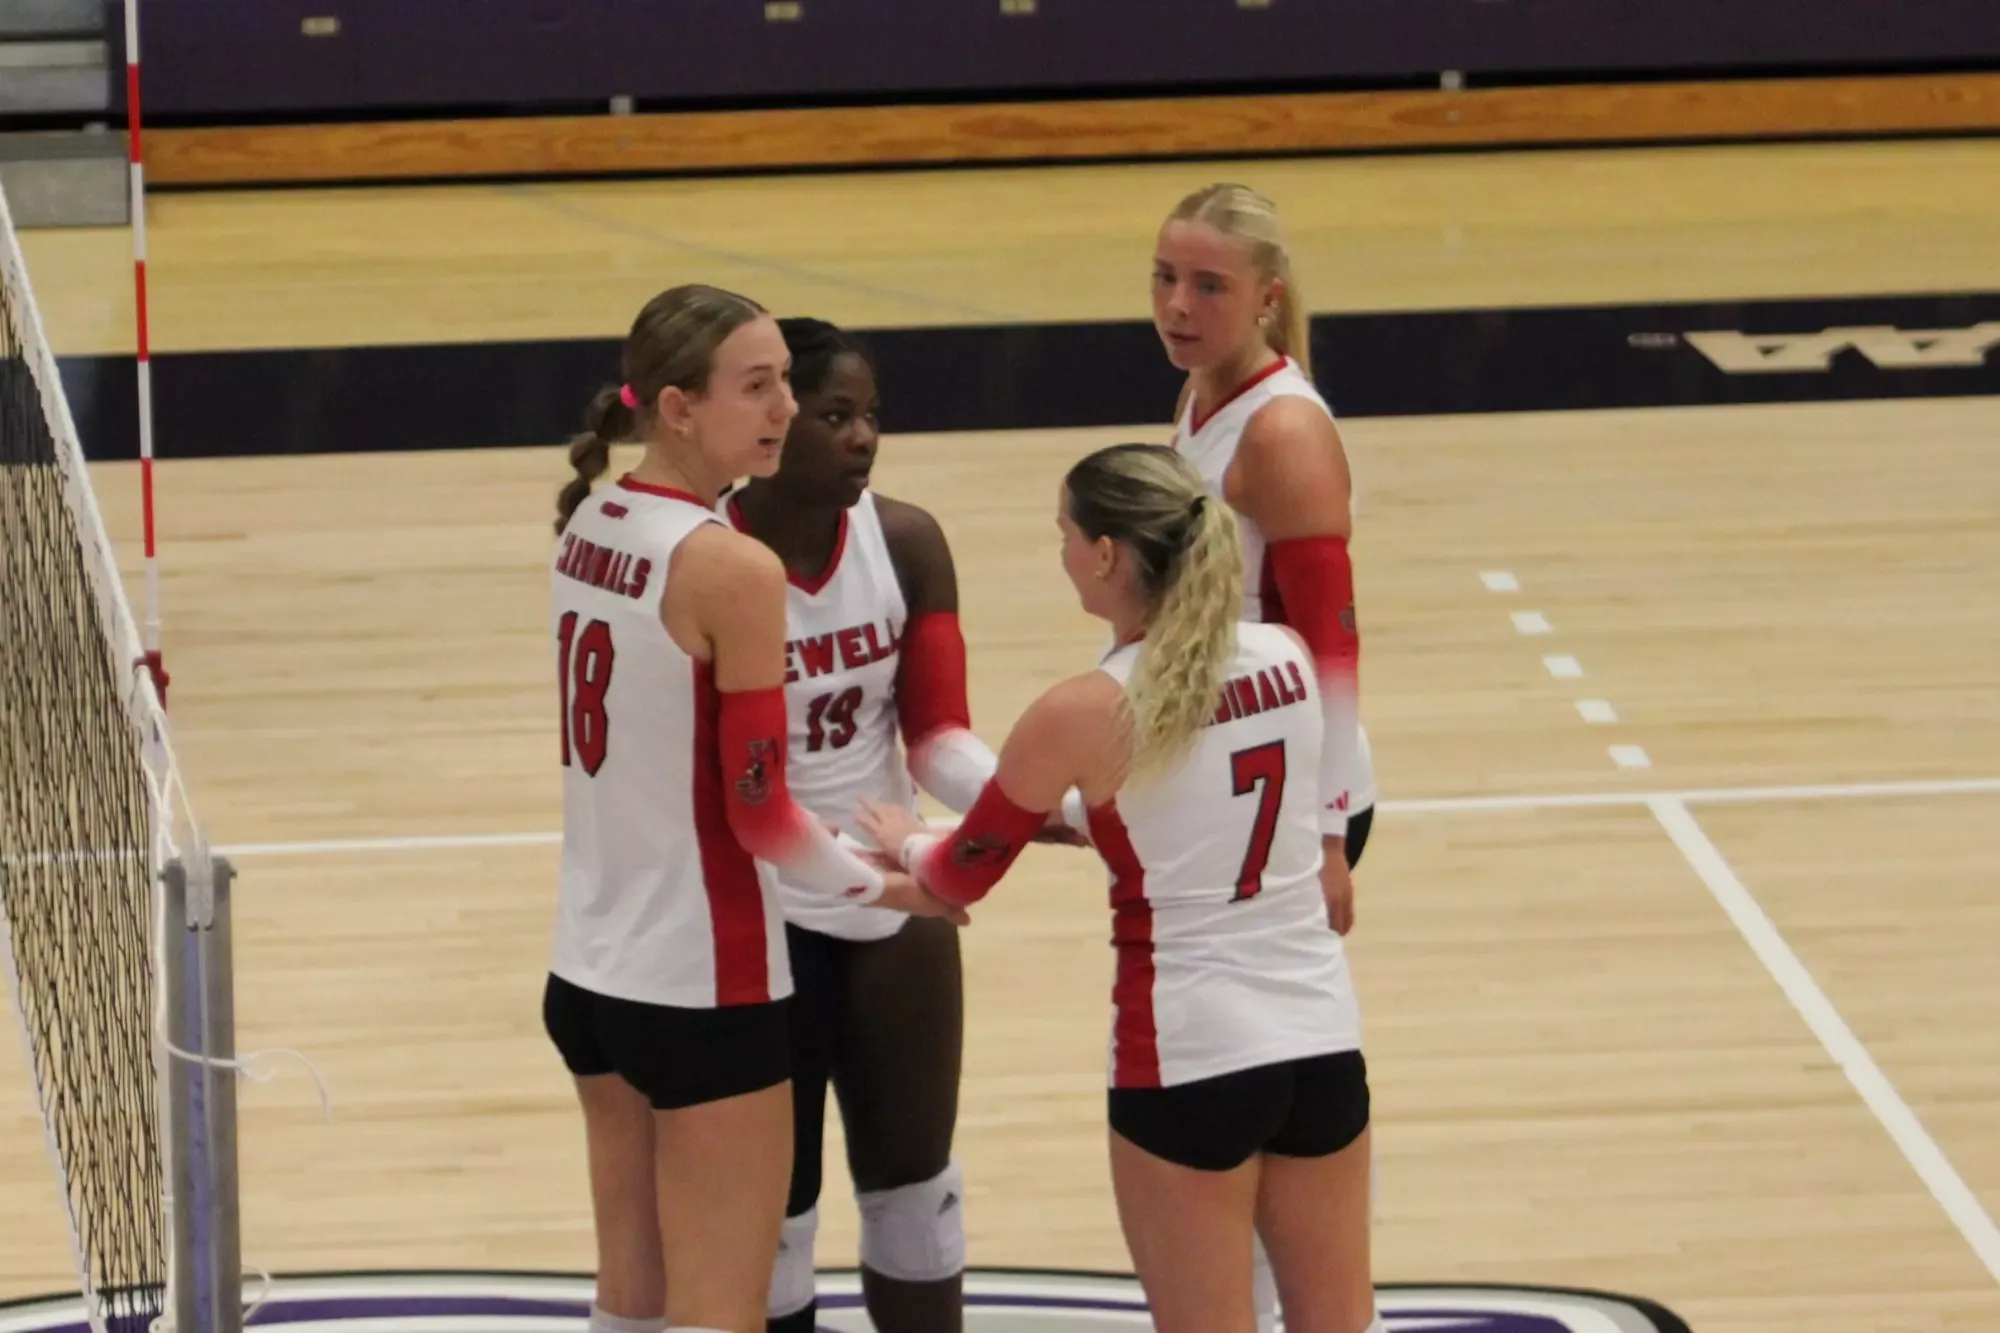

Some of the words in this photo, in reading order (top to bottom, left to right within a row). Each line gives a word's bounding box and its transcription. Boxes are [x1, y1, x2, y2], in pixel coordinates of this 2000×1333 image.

[557, 610, 615, 778] 18
[806, 685, 863, 752] 19
[1228, 738, 1286, 903] 7
